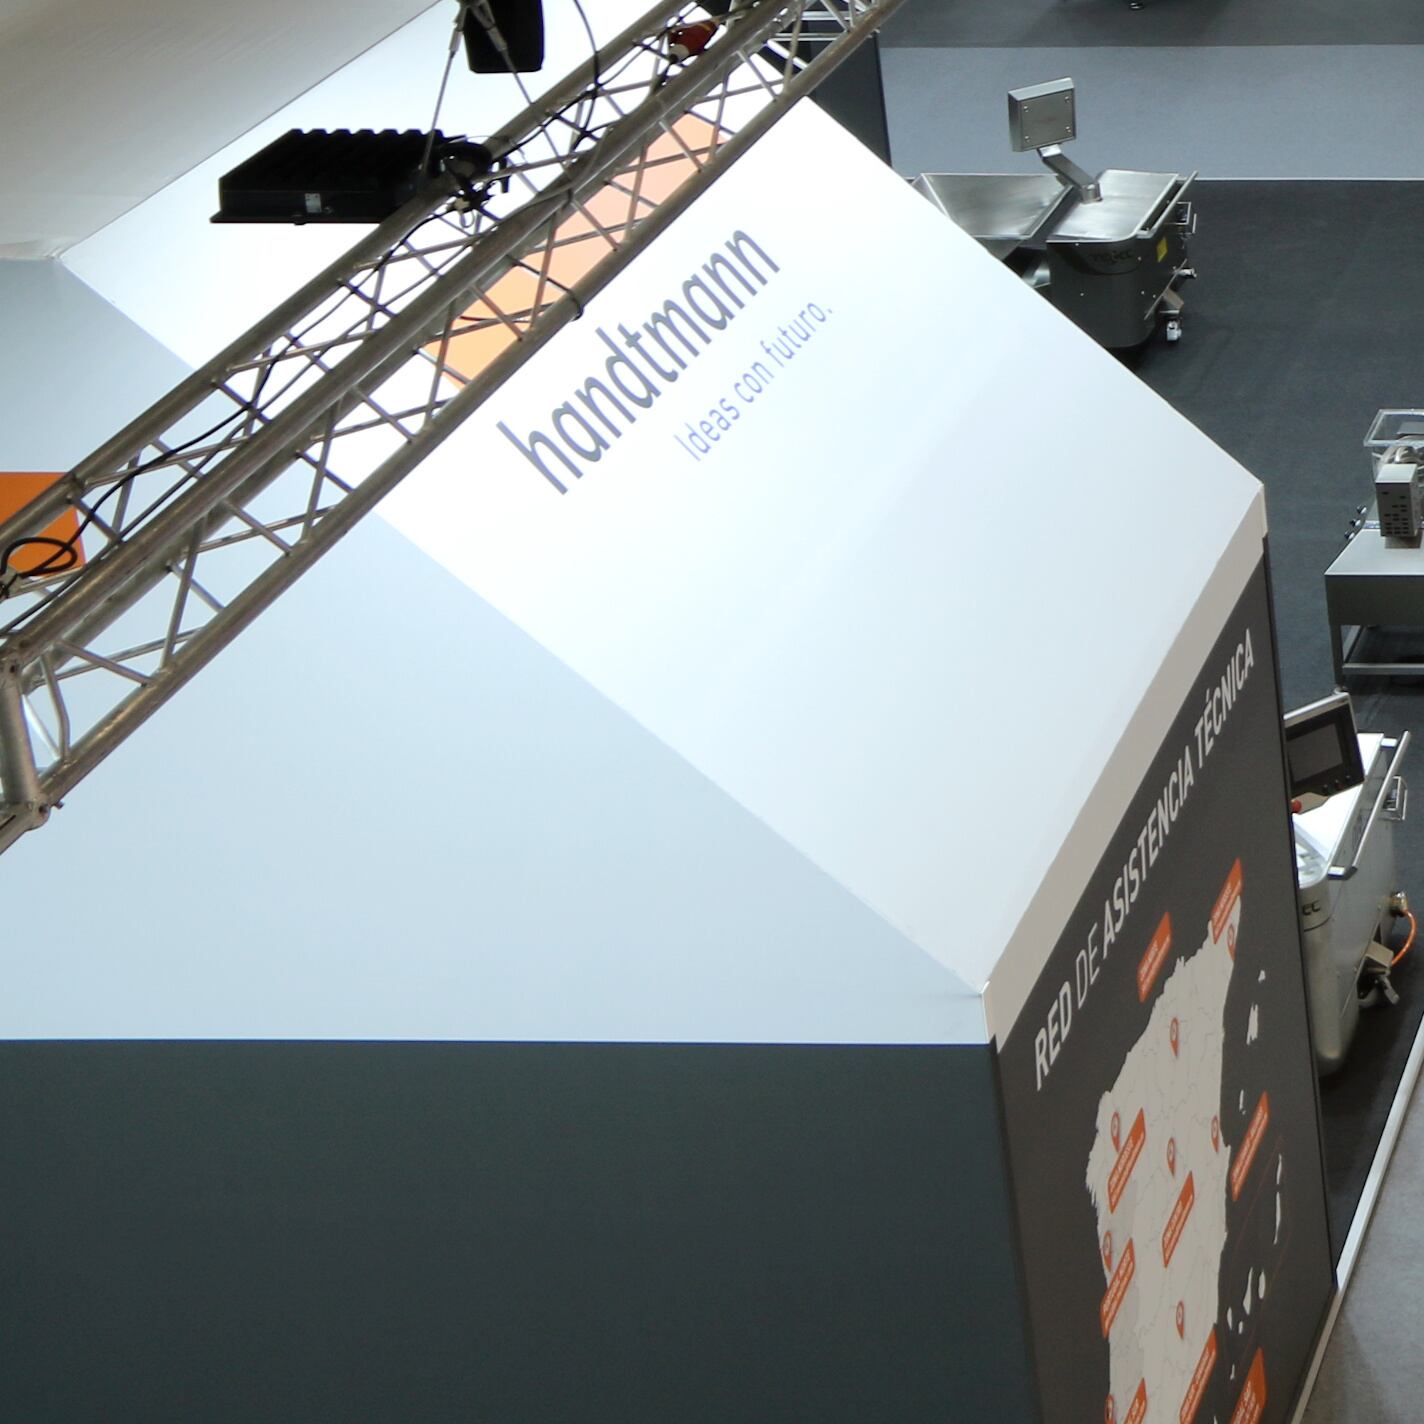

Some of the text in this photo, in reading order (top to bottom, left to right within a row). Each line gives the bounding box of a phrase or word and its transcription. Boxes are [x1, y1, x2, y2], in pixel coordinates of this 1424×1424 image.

[496, 229, 781, 496] handtmann
[673, 301, 835, 463] Ideas con futuro.
[1035, 990, 1075, 1093] RED
[1074, 922, 1103, 1008] DE
[1101, 744, 1197, 957] ASISTENCIA
[1192, 628, 1256, 772] TÉCNICA
